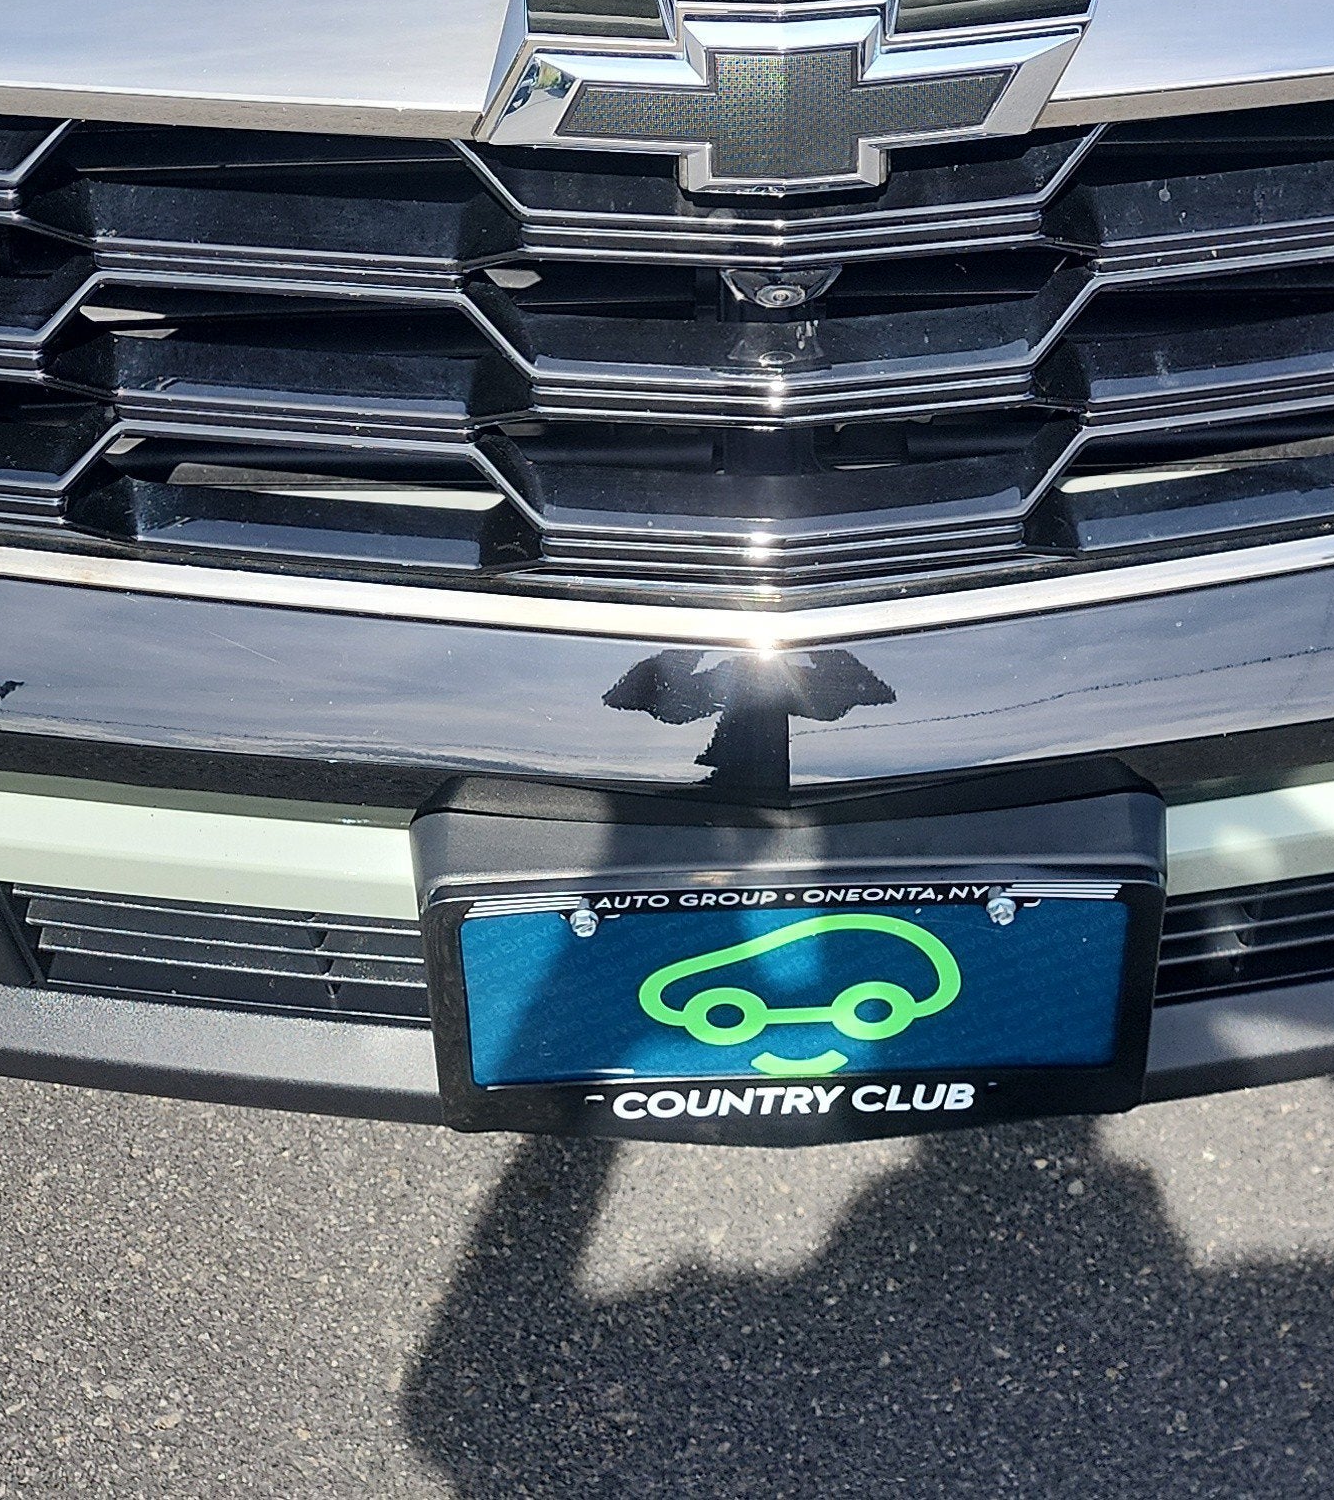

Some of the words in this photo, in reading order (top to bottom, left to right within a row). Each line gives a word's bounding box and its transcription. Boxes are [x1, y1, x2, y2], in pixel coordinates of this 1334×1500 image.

[594, 894, 670, 910] AUTO
[678, 891, 778, 907] GROUP
[802, 887, 944, 903] ONEONTA,
[948, 885, 990, 899] NY
[612, 1084, 846, 1120] COUNTRY
[851, 1082, 976, 1112] CLUB
